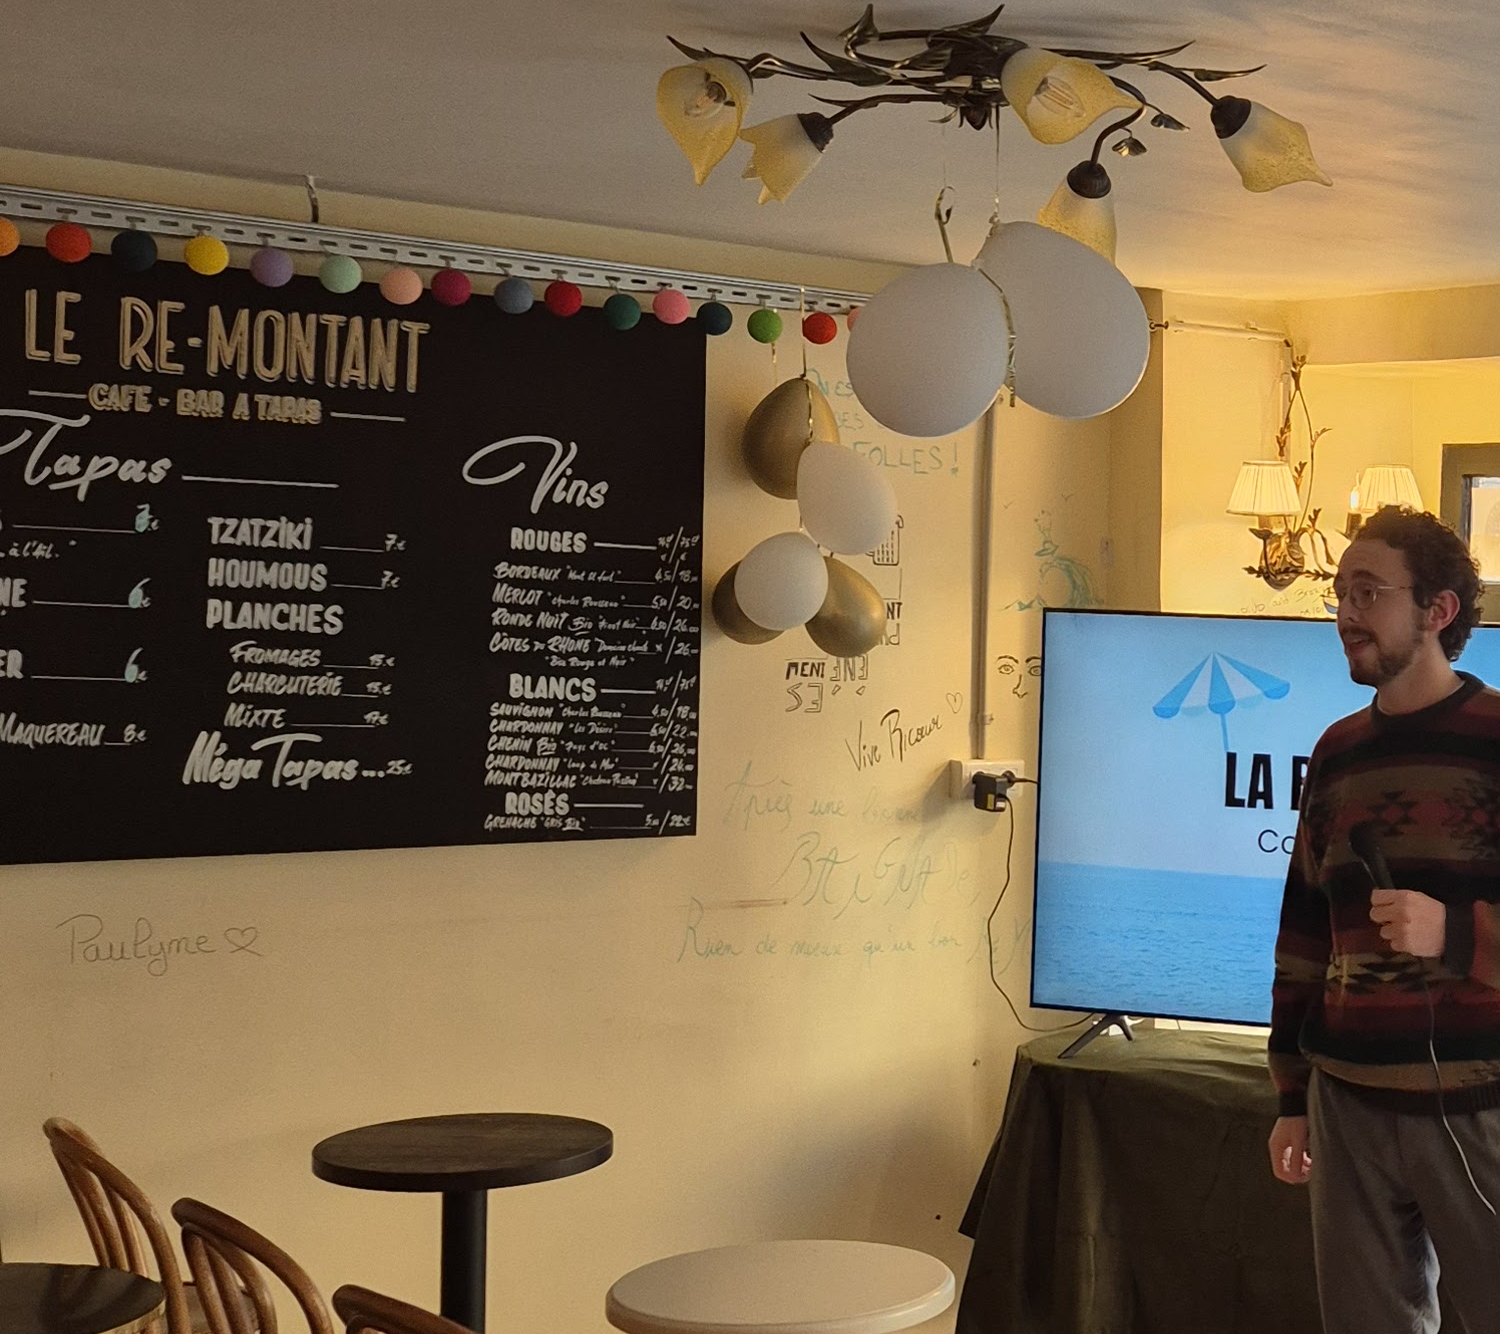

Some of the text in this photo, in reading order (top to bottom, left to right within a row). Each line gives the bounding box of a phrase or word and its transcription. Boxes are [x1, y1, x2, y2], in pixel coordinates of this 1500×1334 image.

[25, 289, 431, 394] LE RE-MONTANT
[87, 383, 153, 413] CAFE
[176, 388, 224, 419] BAR
[232, 393, 250, 421] A
[254, 394, 322, 425] TAPAS
[0, 408, 172, 502] Tapas
[462, 435, 609, 514] Vins
[510, 526, 588, 554] ROUGES
[207, 557, 328, 592] HOUMOUS
[493, 561, 562, 581] BORDEAUX
[492, 582, 543, 605] MERLOT
[206, 598, 344, 635] PLANCHES
[491, 607, 533, 628] RONDE
[229, 640, 321, 667] FROMAGES
[508, 672, 597, 702] BLANCS
[489, 702, 553, 717] SAUVIGNON
[489, 718, 563, 735] CHARDONNAY
[487, 734, 531, 753] CHENIN
[182, 730, 263, 790] Méga
[484, 753, 560, 772] CHARDONNAY
[484, 769, 576, 789] MONTBAZILLAC
[1225, 752, 1274, 809] LA
